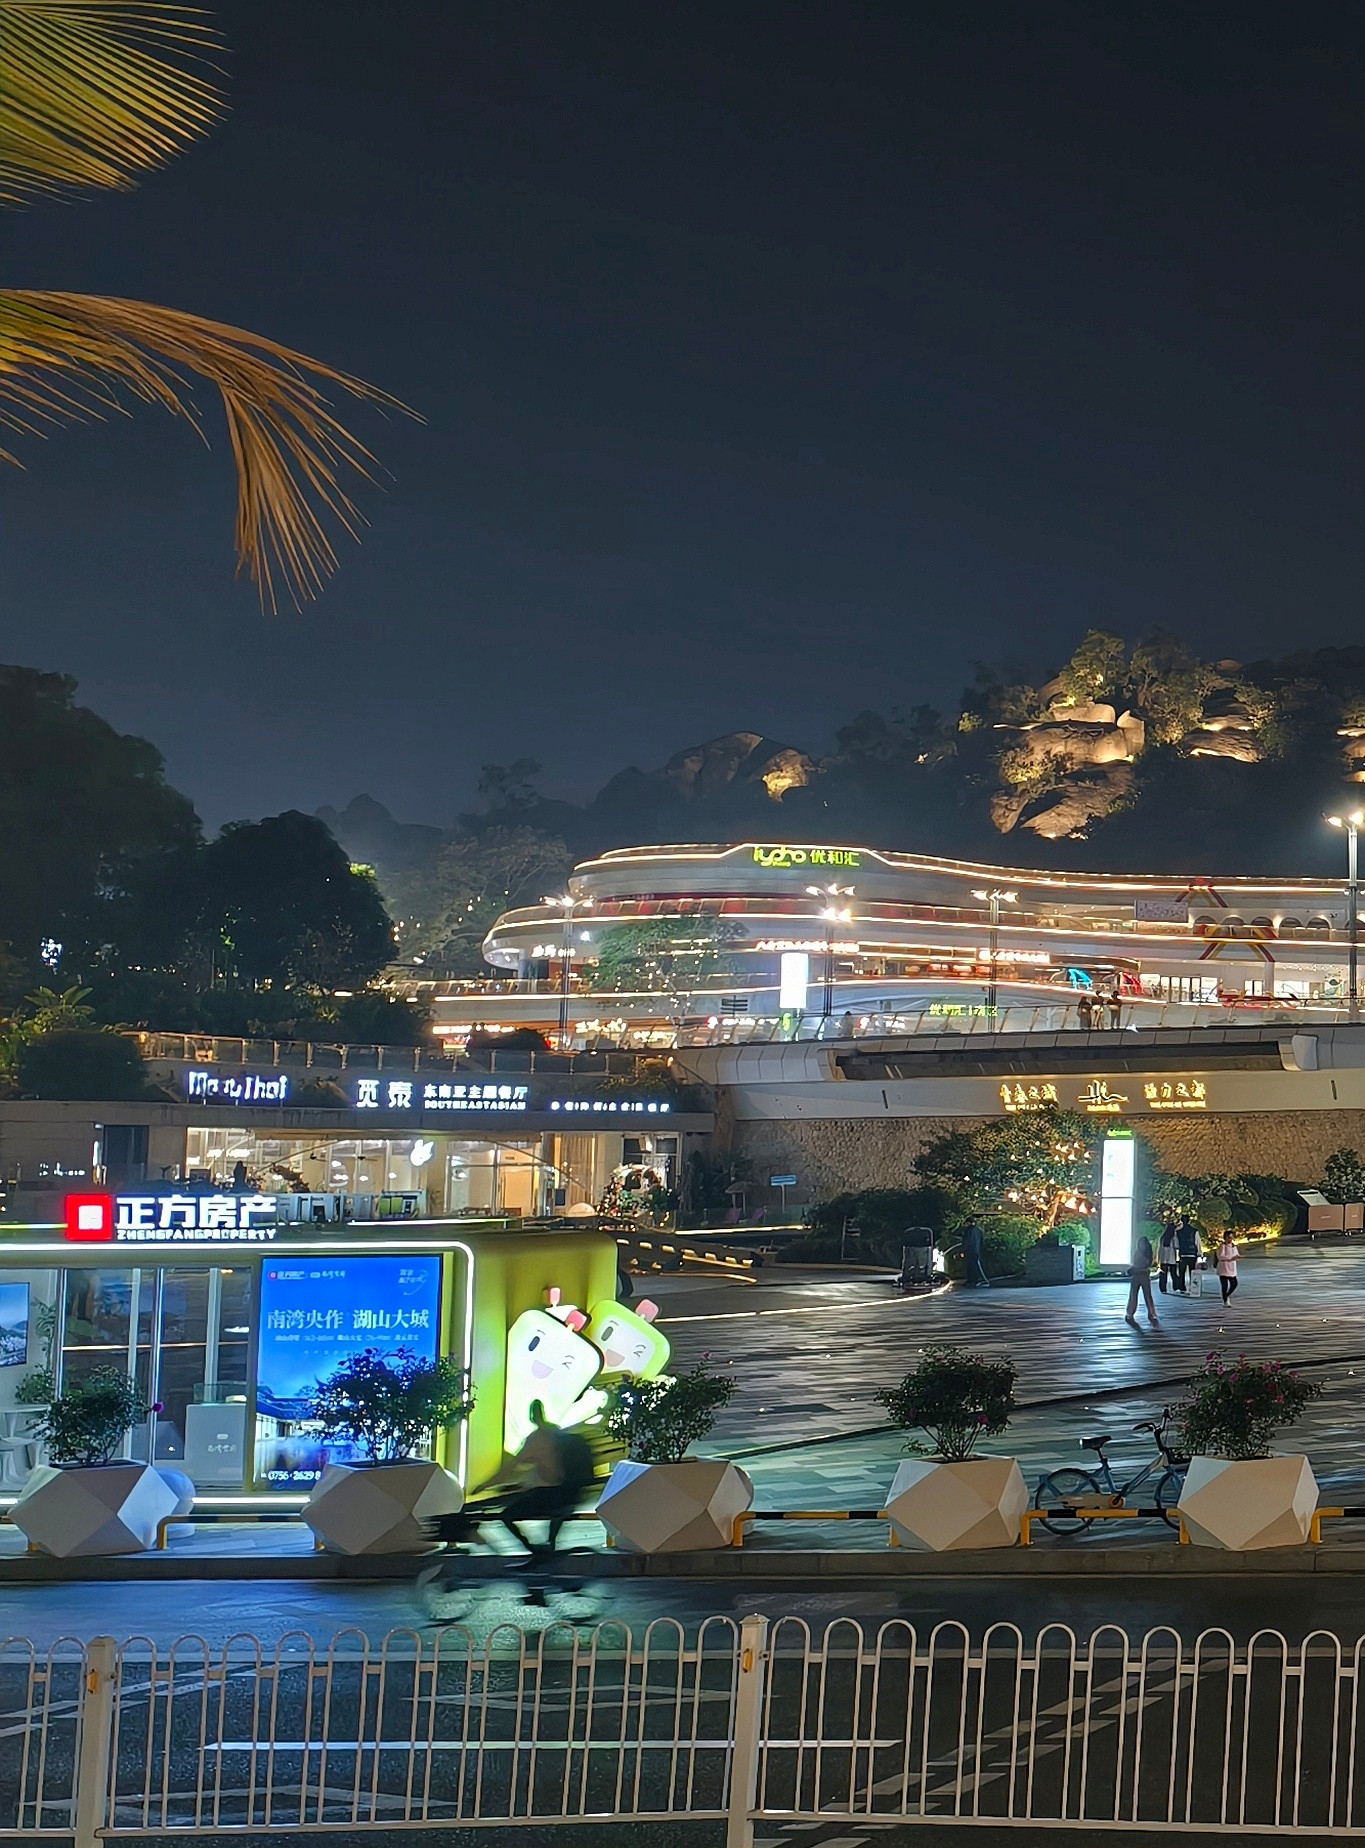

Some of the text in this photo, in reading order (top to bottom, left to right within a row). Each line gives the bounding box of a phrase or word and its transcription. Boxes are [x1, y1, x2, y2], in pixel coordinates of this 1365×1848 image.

[116, 1194, 277, 1229] 正方房产
[267, 1309, 430, 1330] 南湾央作 湖山大城
